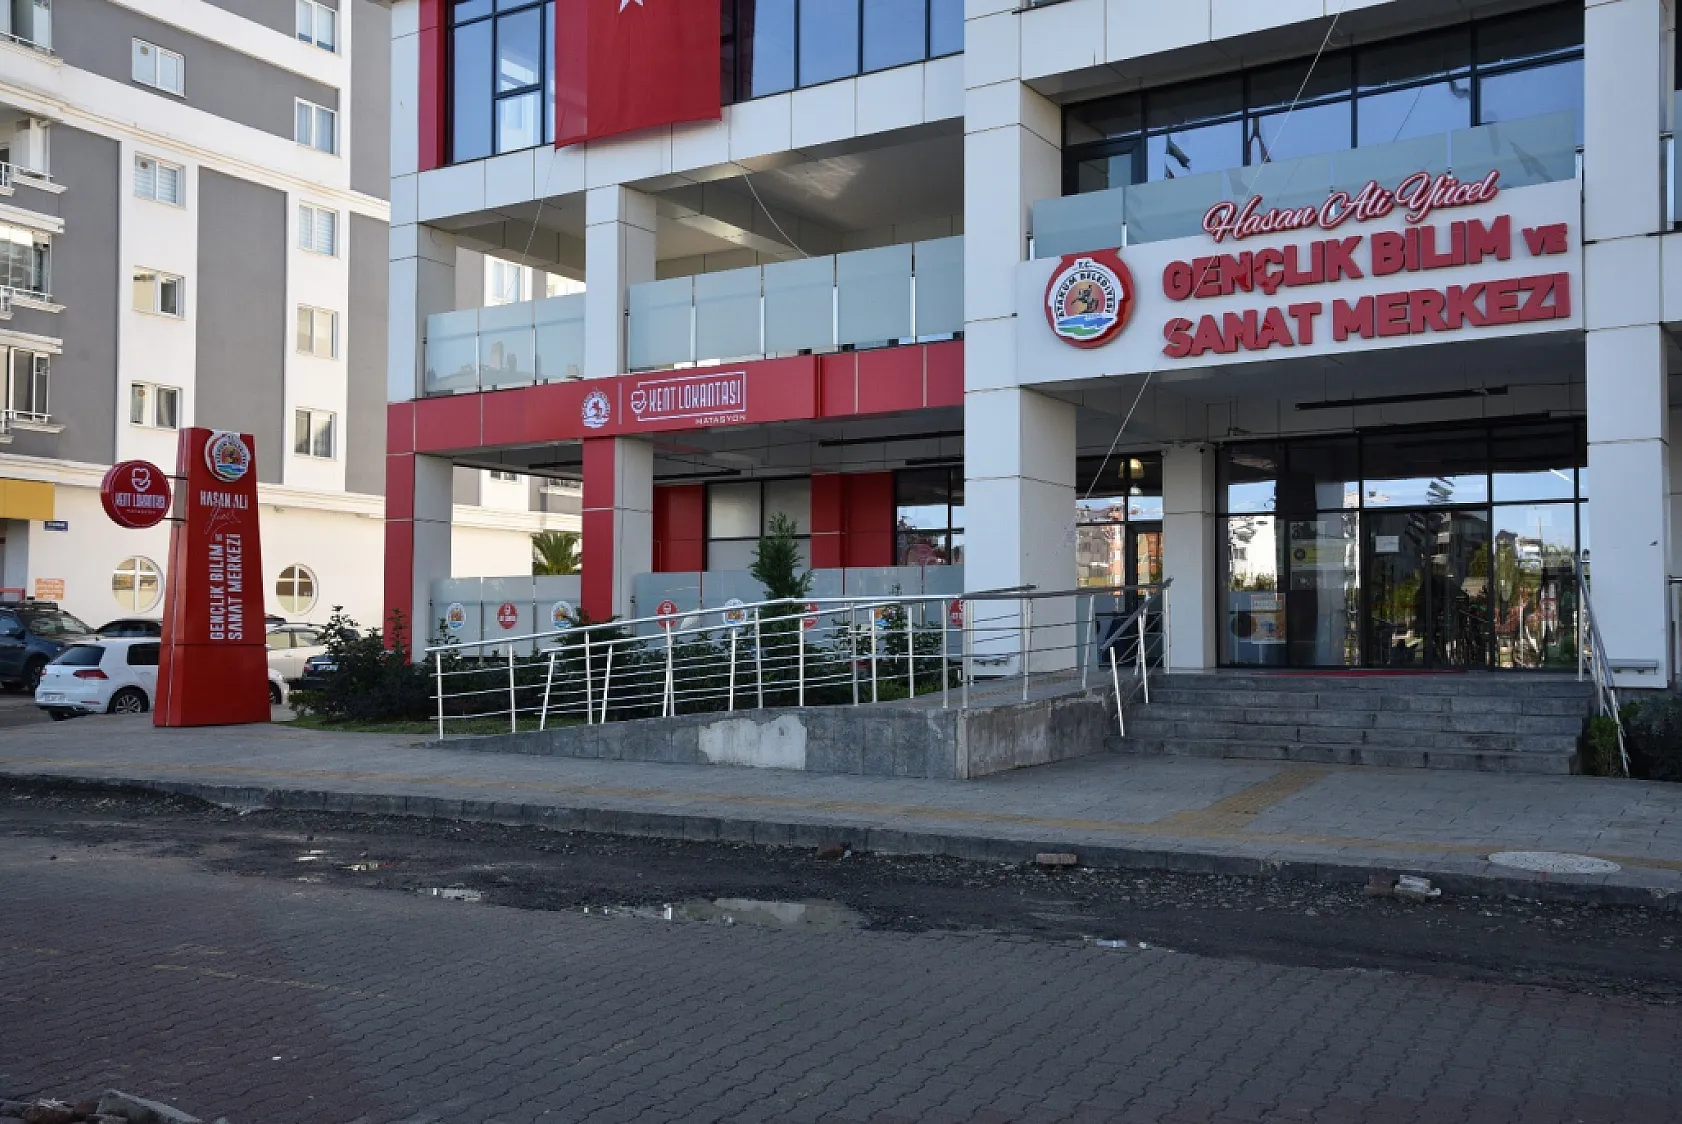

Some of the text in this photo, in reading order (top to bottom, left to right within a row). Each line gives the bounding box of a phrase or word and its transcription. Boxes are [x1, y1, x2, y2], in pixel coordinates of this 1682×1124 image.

[1202, 168, 1500, 243] Hasan Ali Yücel
[1522, 222, 1568, 256] VE
[1163, 302, 1322, 359] SANAT
[649, 379, 741, 412] KENT LOKANTASI
[200, 490, 230, 508] HASAN
[227, 596, 243, 640] SANAT
